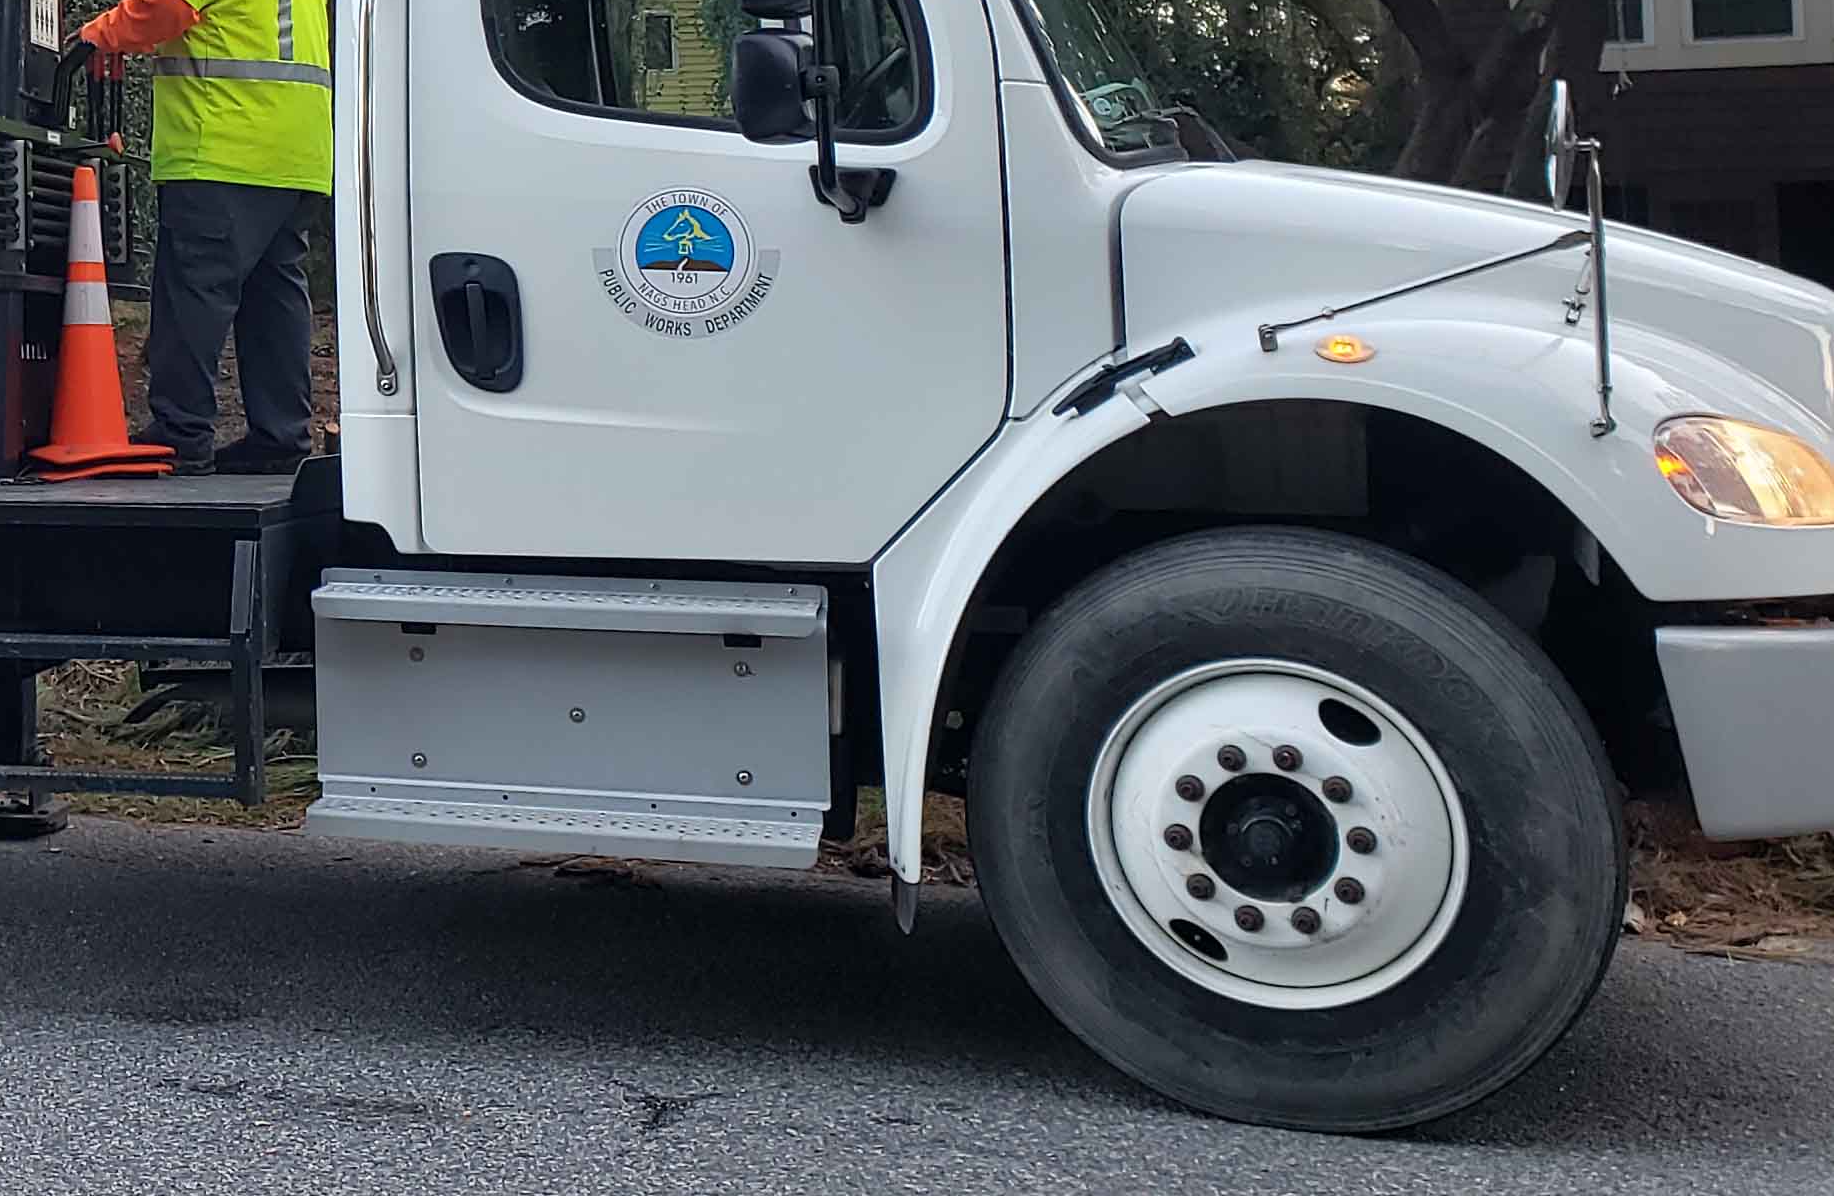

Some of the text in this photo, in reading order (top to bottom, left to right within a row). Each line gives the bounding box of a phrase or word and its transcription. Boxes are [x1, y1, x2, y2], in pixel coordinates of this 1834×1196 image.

[645, 193, 728, 217] THE TOWN OF
[670, 272, 699, 284] 1961
[599, 269, 773, 336] PUBLIC WORKS DEPARTMENT
[637, 283, 668, 307] NAGS
[672, 298, 706, 311] HEAD
